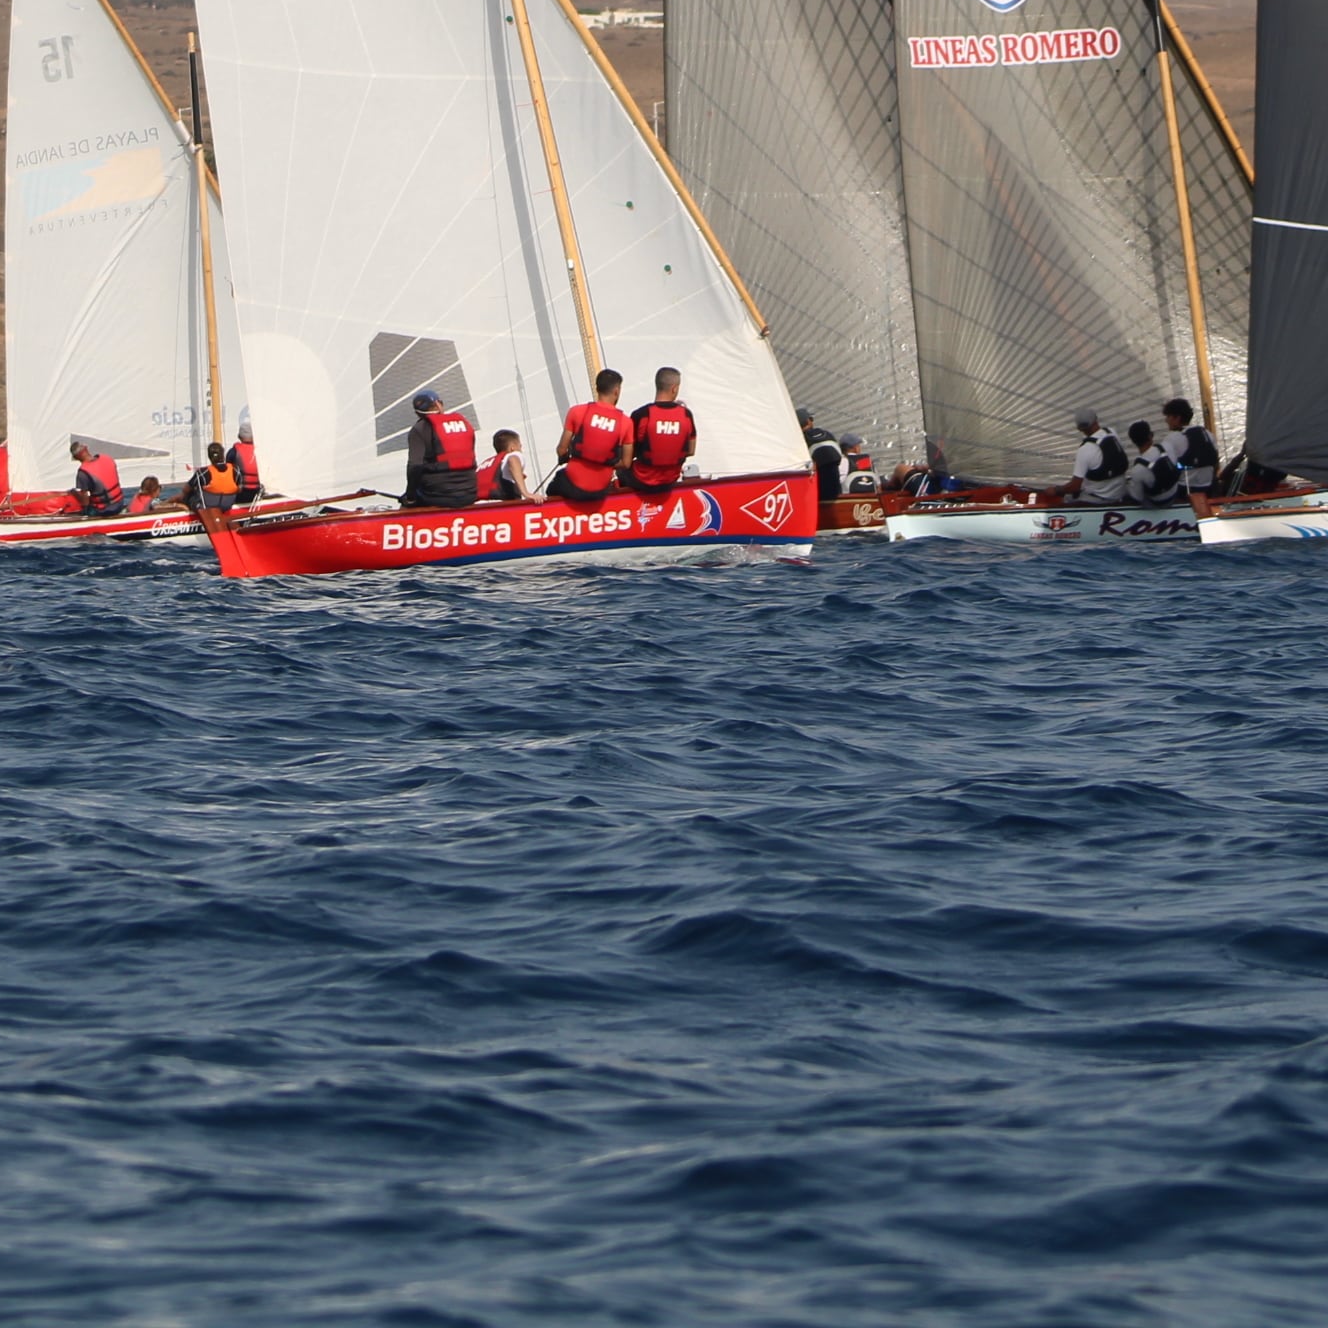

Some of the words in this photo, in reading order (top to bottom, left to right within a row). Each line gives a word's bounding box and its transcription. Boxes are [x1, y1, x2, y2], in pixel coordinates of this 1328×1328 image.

[909, 36, 998, 67] LINEAS
[1000, 27, 1121, 65] ROMERO
[442, 419, 467, 434] HH
[590, 414, 616, 432] HH
[655, 420, 680, 435] HH
[762, 493, 788, 523] 97
[382, 517, 512, 551] Biosfera
[524, 508, 633, 544] Express
[1098, 511, 1201, 537] Rom
